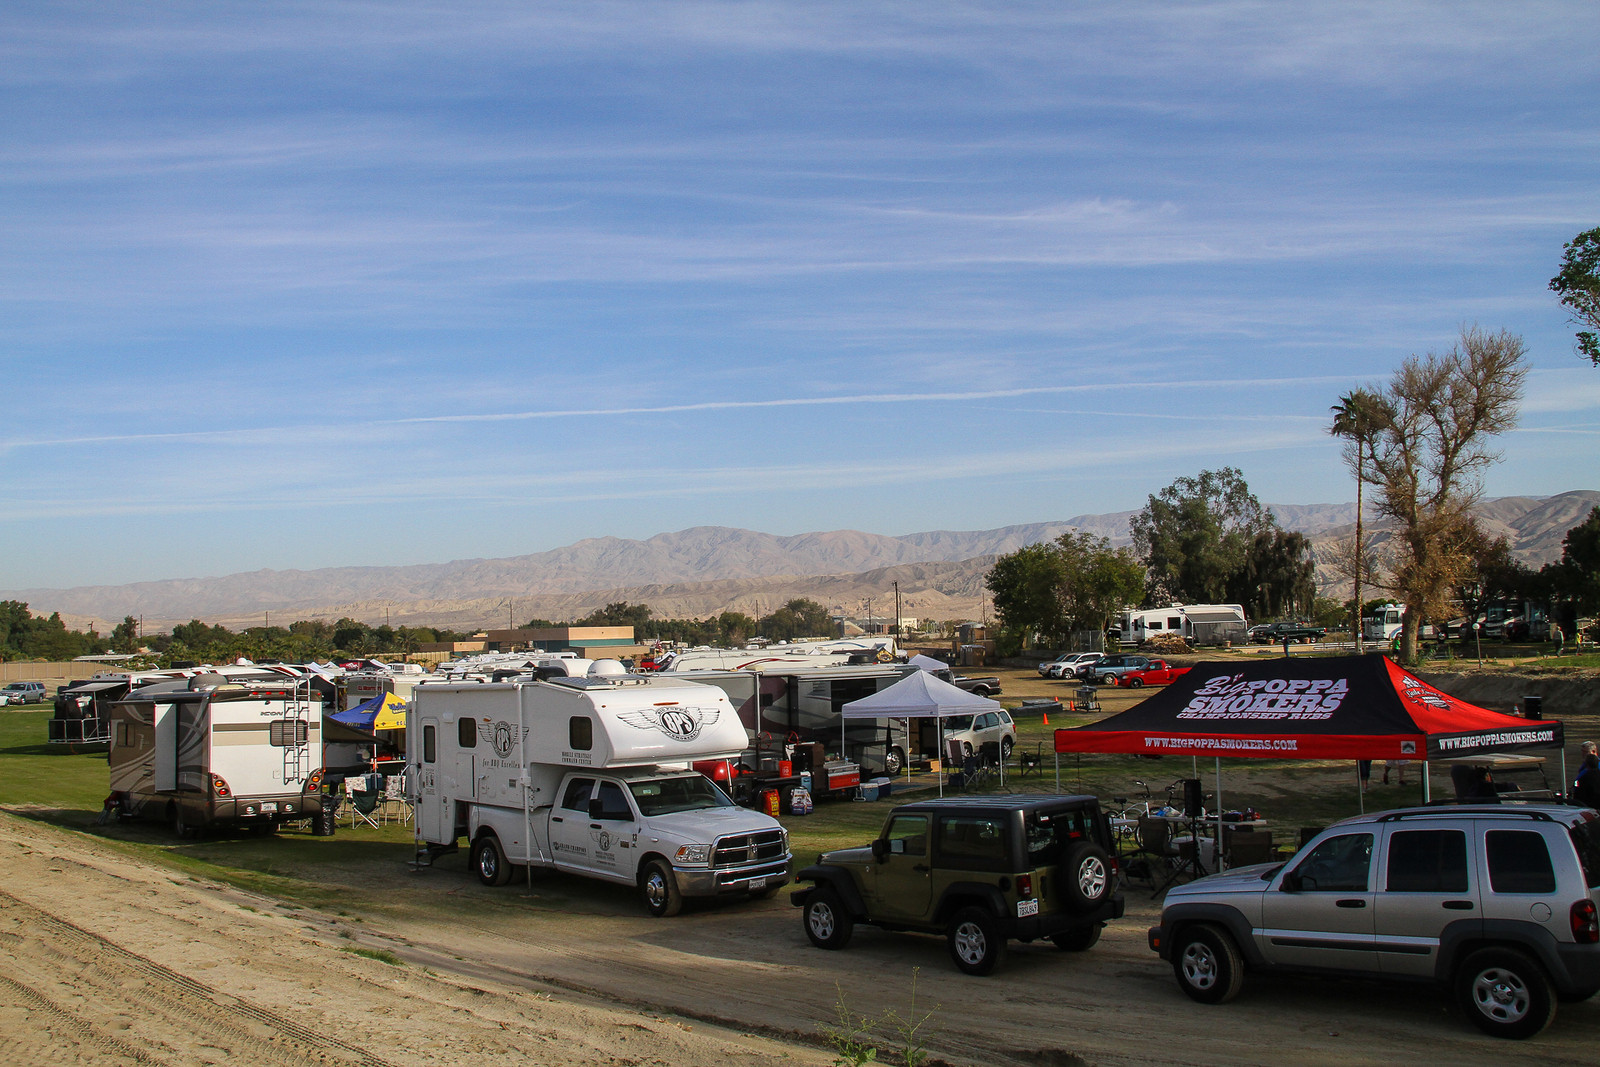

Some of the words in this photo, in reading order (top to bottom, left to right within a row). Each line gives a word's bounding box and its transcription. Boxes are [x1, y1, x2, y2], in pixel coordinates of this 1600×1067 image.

[1194, 673, 1248, 699] Big
[1243, 679, 1349, 694] POPPA
[1181, 693, 1347, 713] SMOKERS
[662, 712, 694, 735] BPS
[1176, 712, 1286, 720] CHAMPIONSHIP
[1287, 712, 1333, 720] RUBS
[1144, 737, 1298, 751] WWW.BIGPOPPASMOKERS.COM
[1438, 730, 1554, 750] WWW.BIGPOPPASMOKERS.COM
[501, 759, 526, 769] Excellene
